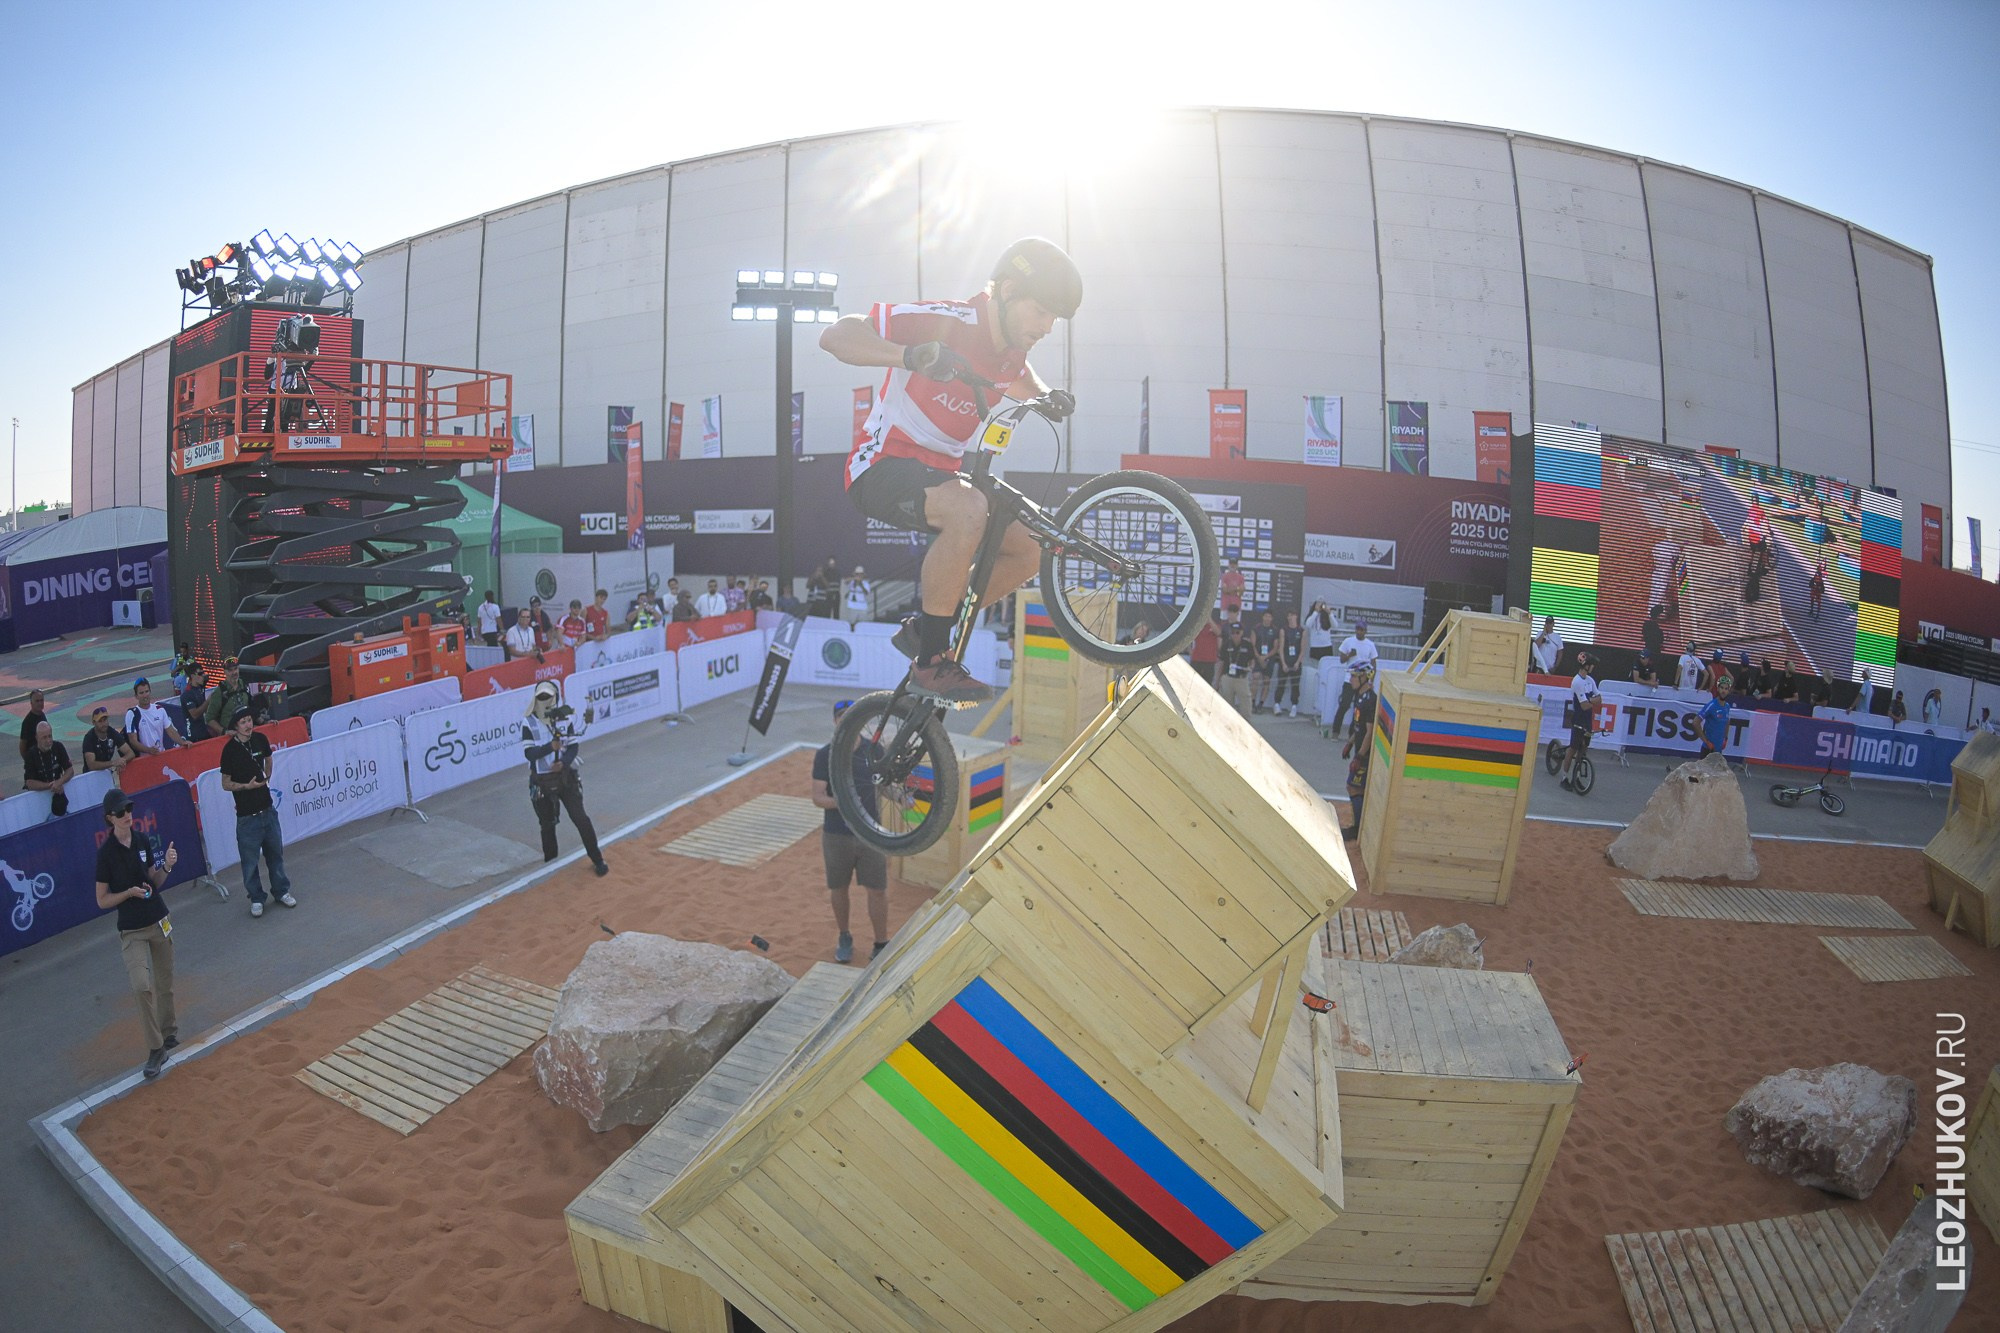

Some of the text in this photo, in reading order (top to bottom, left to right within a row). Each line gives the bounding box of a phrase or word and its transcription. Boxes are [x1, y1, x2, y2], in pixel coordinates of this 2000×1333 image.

[996, 430, 1008, 445] 5
[1392, 426, 1425, 436] RIYADH
[304, 436, 331, 445] SUDHIR
[1307, 440, 1338, 448] RIYADH
[195, 442, 220, 459] SUDHIR
[587, 517, 613, 531] UCI
[1451, 522, 1485, 539] 2025
[1470, 541, 1492, 549] CYCLING
[1326, 551, 1355, 561] ARABIA
[23, 561, 153, 606] DINING CE
[784, 621, 795, 644] 1
[1922, 625, 1942, 641] UCI
[374, 646, 398, 658] SUDHIR
[535, 664, 563, 681] RIYADH
[713, 653, 739, 678] UCI
[593, 685, 612, 701] UCI
[1622, 704, 1750, 747] TISST
[471, 726, 505, 746] SAUDI
[1815, 731, 1919, 768] SHIMANO
[292, 760, 377, 795] وزارة الرياضة
[294, 778, 379, 817] Ministry of Sport
